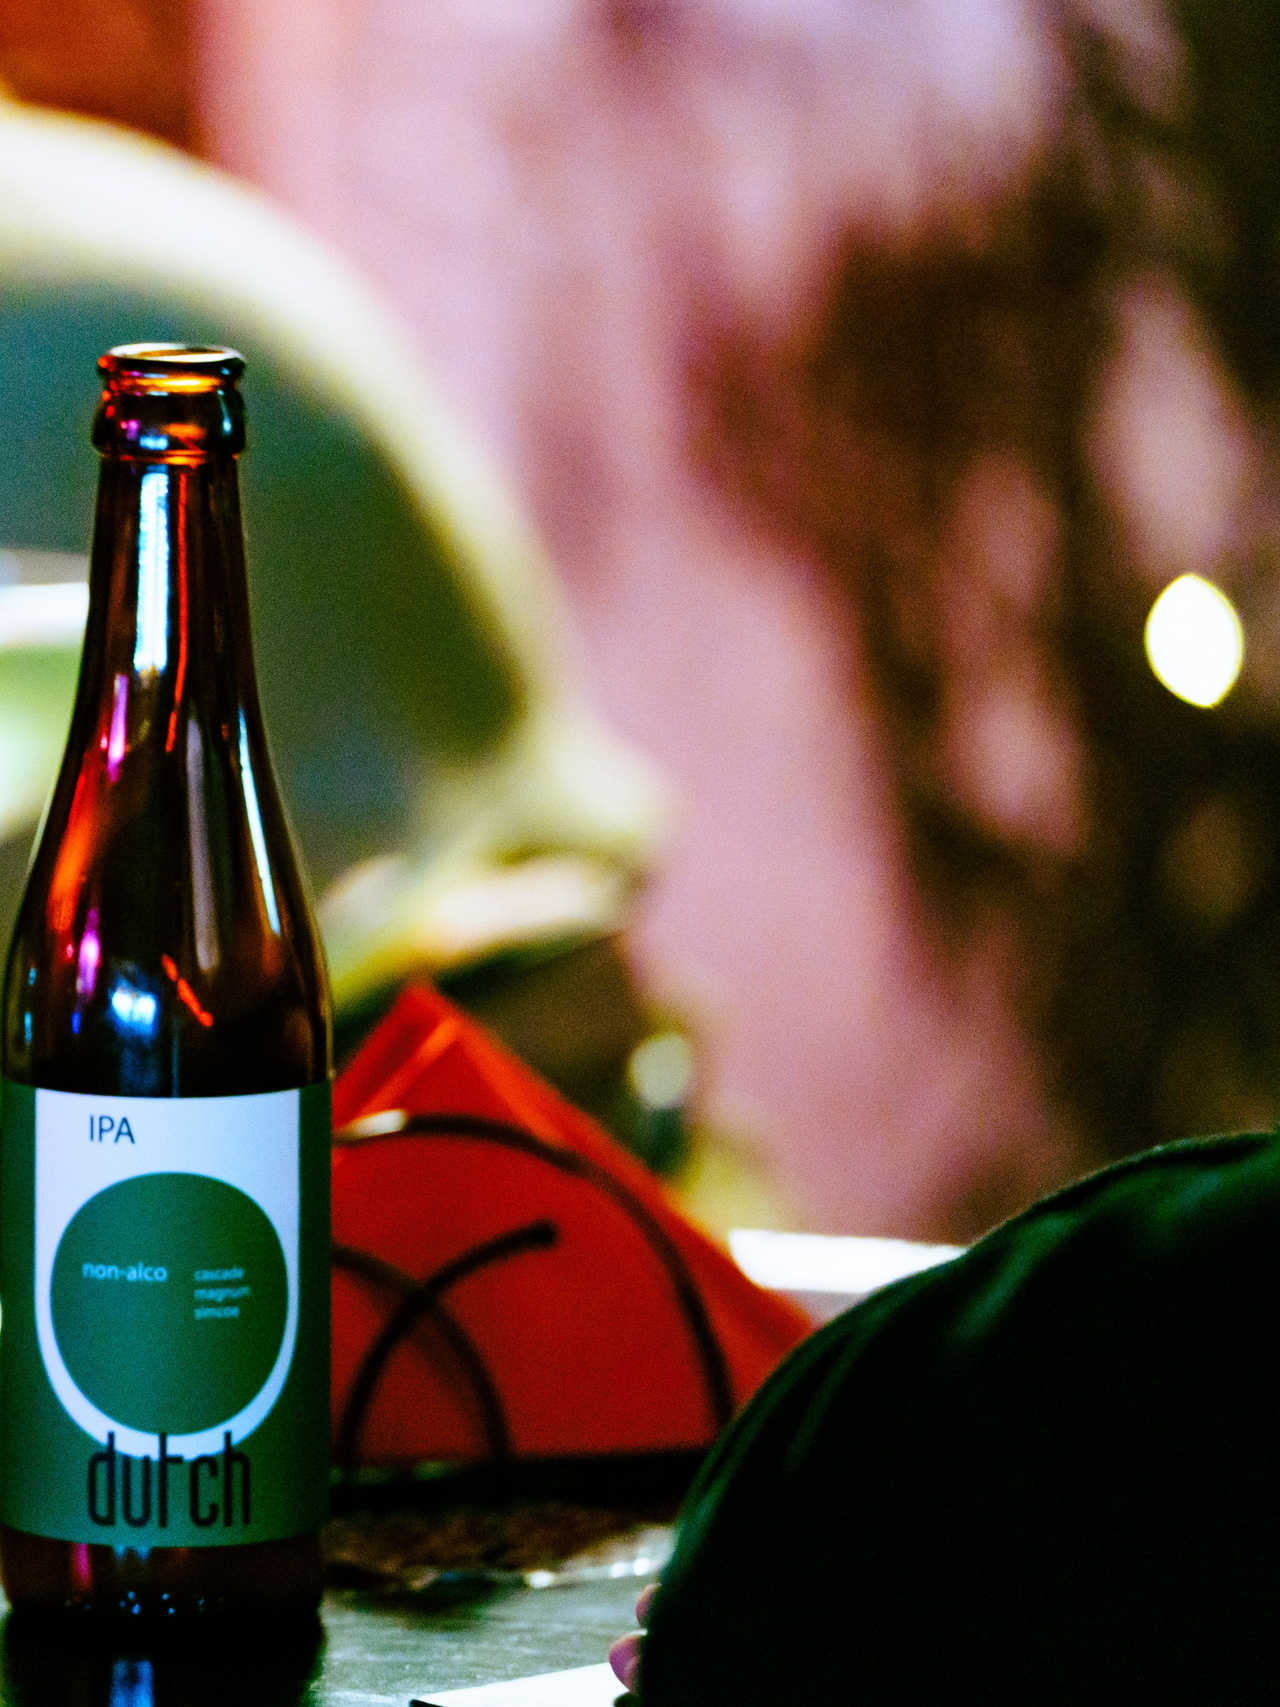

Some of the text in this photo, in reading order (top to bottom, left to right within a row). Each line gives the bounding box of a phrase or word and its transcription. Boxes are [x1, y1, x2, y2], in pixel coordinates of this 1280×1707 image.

[89, 1115, 135, 1144] IPA
[82, 1261, 168, 1282] non-alco
[88, 1431, 250, 1528] dutch
